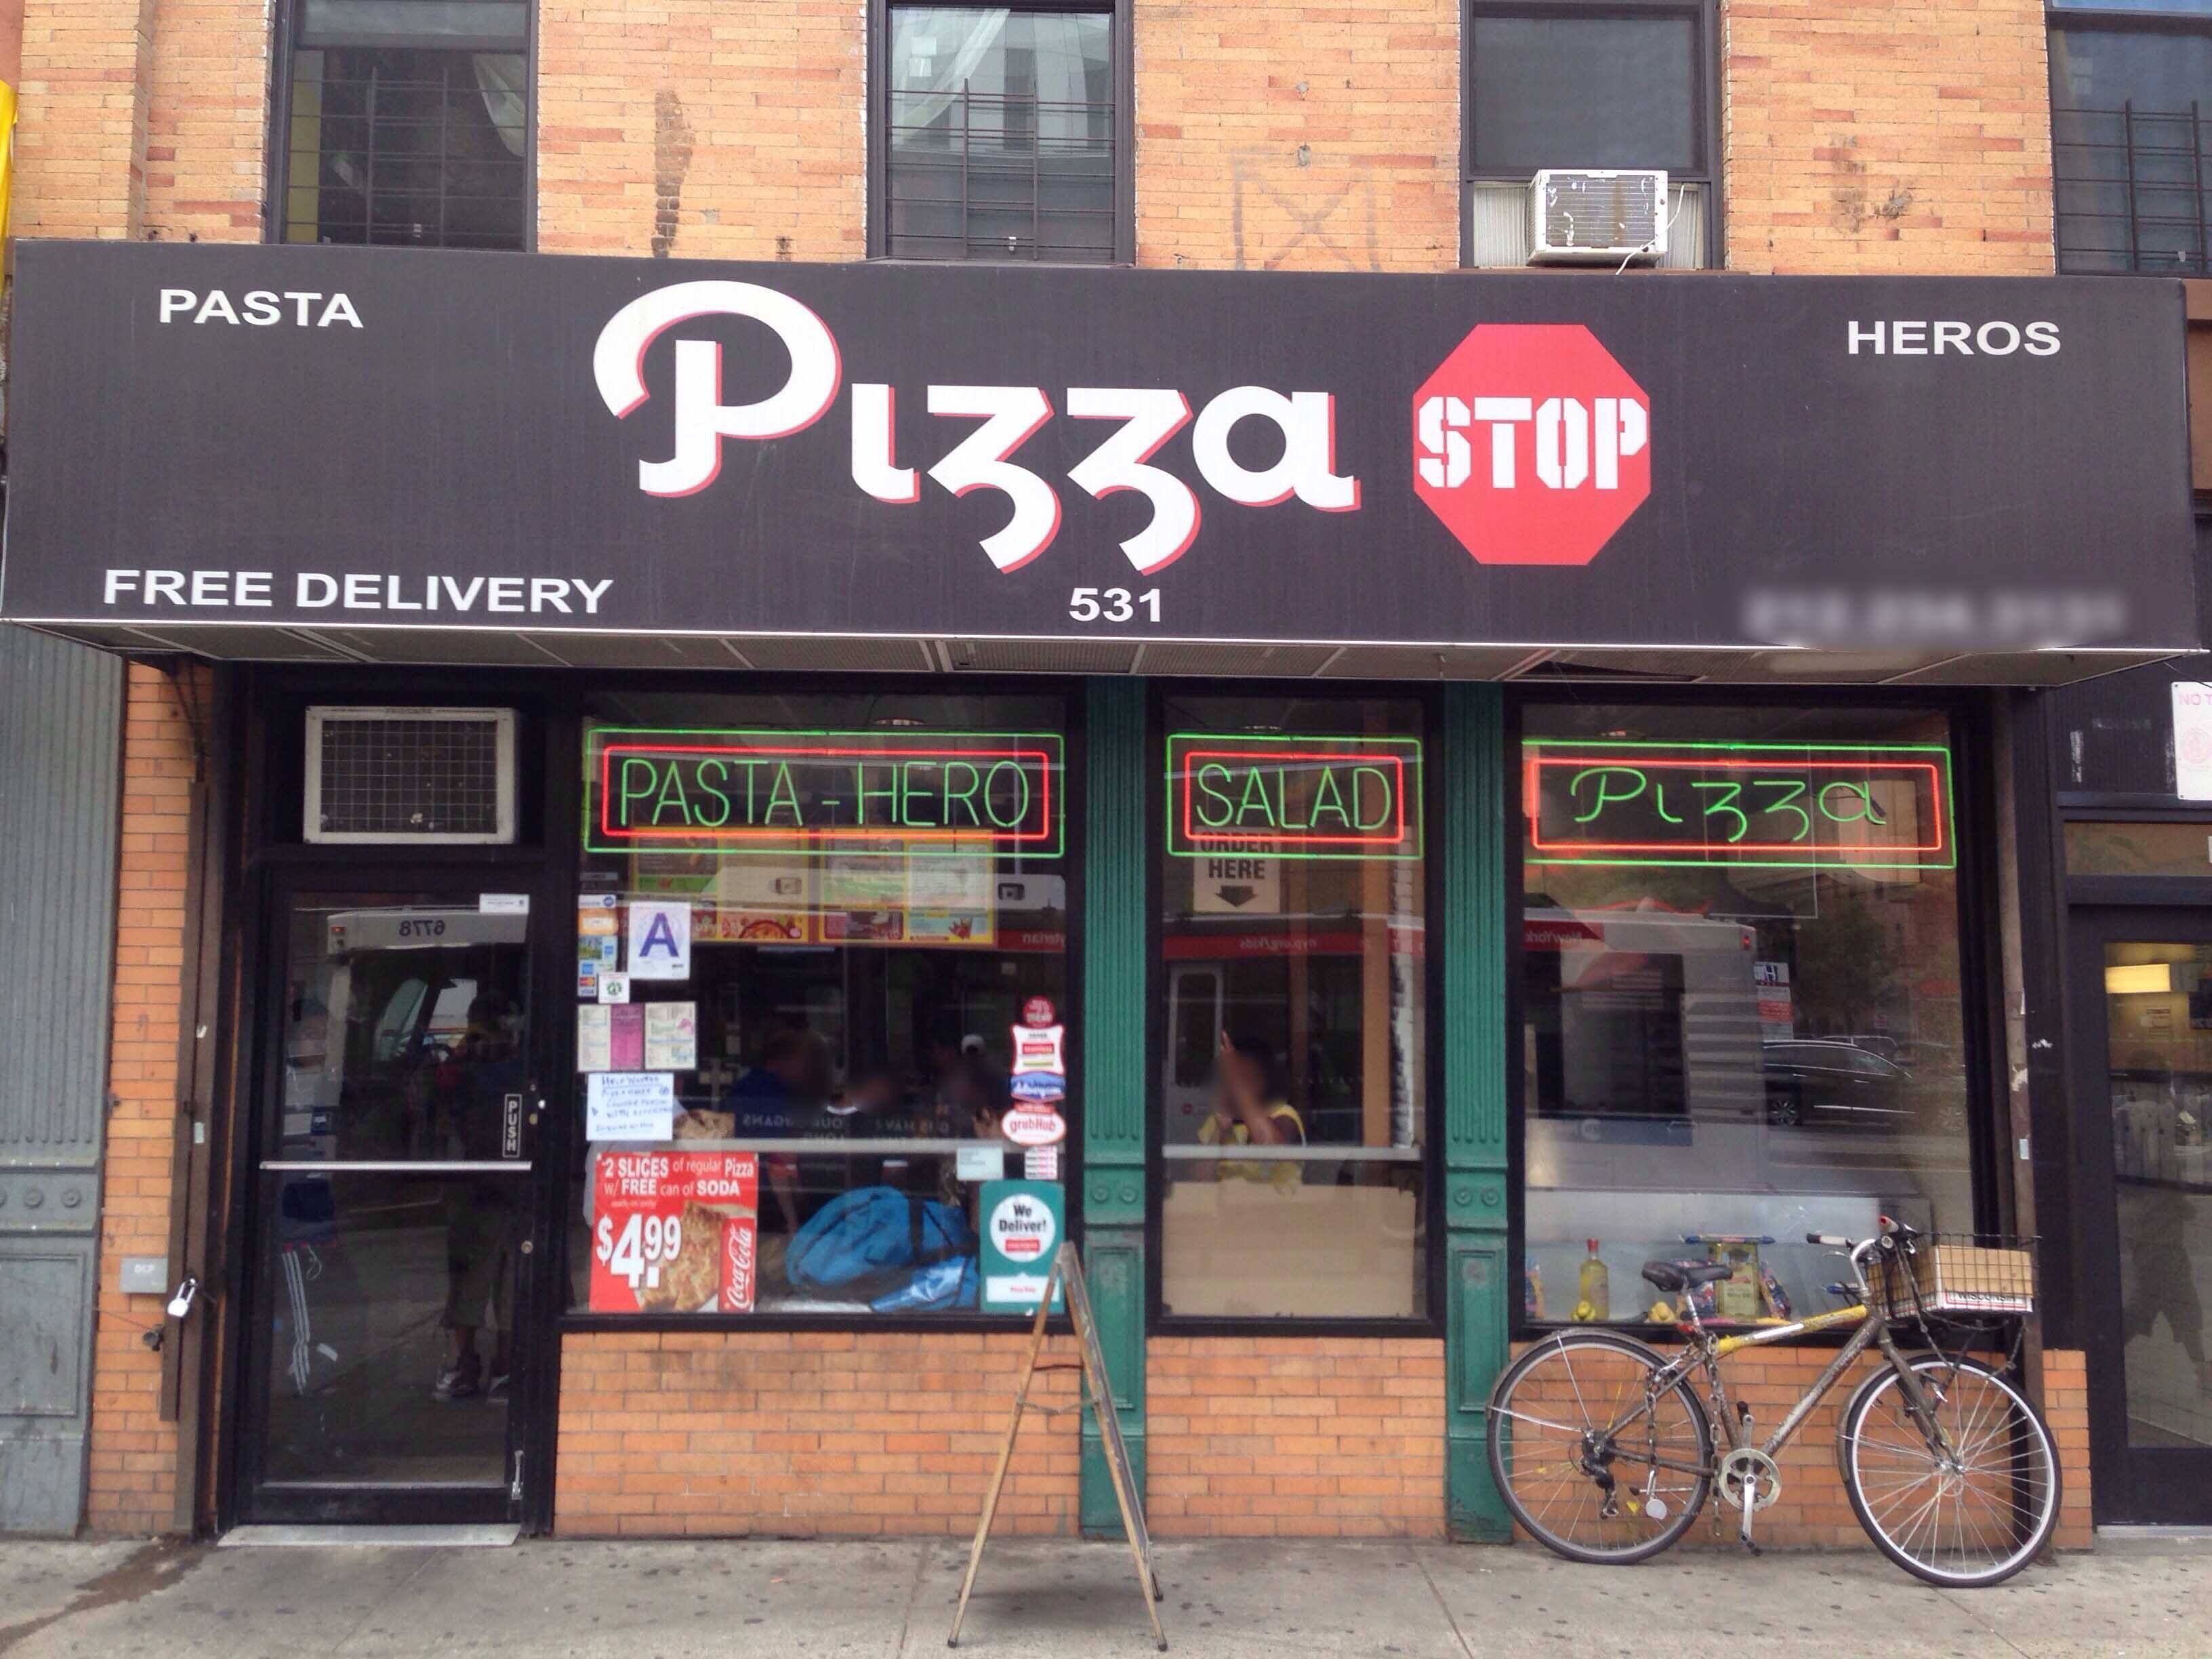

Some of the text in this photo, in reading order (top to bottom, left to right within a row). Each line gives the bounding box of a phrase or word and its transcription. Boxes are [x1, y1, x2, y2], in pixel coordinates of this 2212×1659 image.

[159, 289, 364, 328] PASTA
[1848, 321, 2061, 356] HEROS
[594, 280, 1361, 574] Pizza
[1418, 396, 1647, 489] STOP
[104, 569, 613, 613] FREE DELIVERY
[1069, 588, 1161, 622] 531
[620, 758, 804, 827] PASTA
[858, 759, 1029, 828] HERO
[1196, 763, 1392, 831] SALAD
[1570, 766, 1887, 843] Pizza
[1200, 832, 1275, 853] ORDER
[1208, 859, 1266, 879] HERE
[639, 912, 679, 957] A
[506, 1100, 518, 1151] PUSH
[605, 1157, 754, 1178] 2 SLICES of regular Pizza
[621, 1179, 657, 1196] FREE
[660, 1184, 678, 1196] can
[682, 1182, 695, 1196] of
[697, 1179, 741, 1197] SODA
[998, 1219, 1046, 1233] Deliver!
[1012, 1204, 1032, 1217] We
